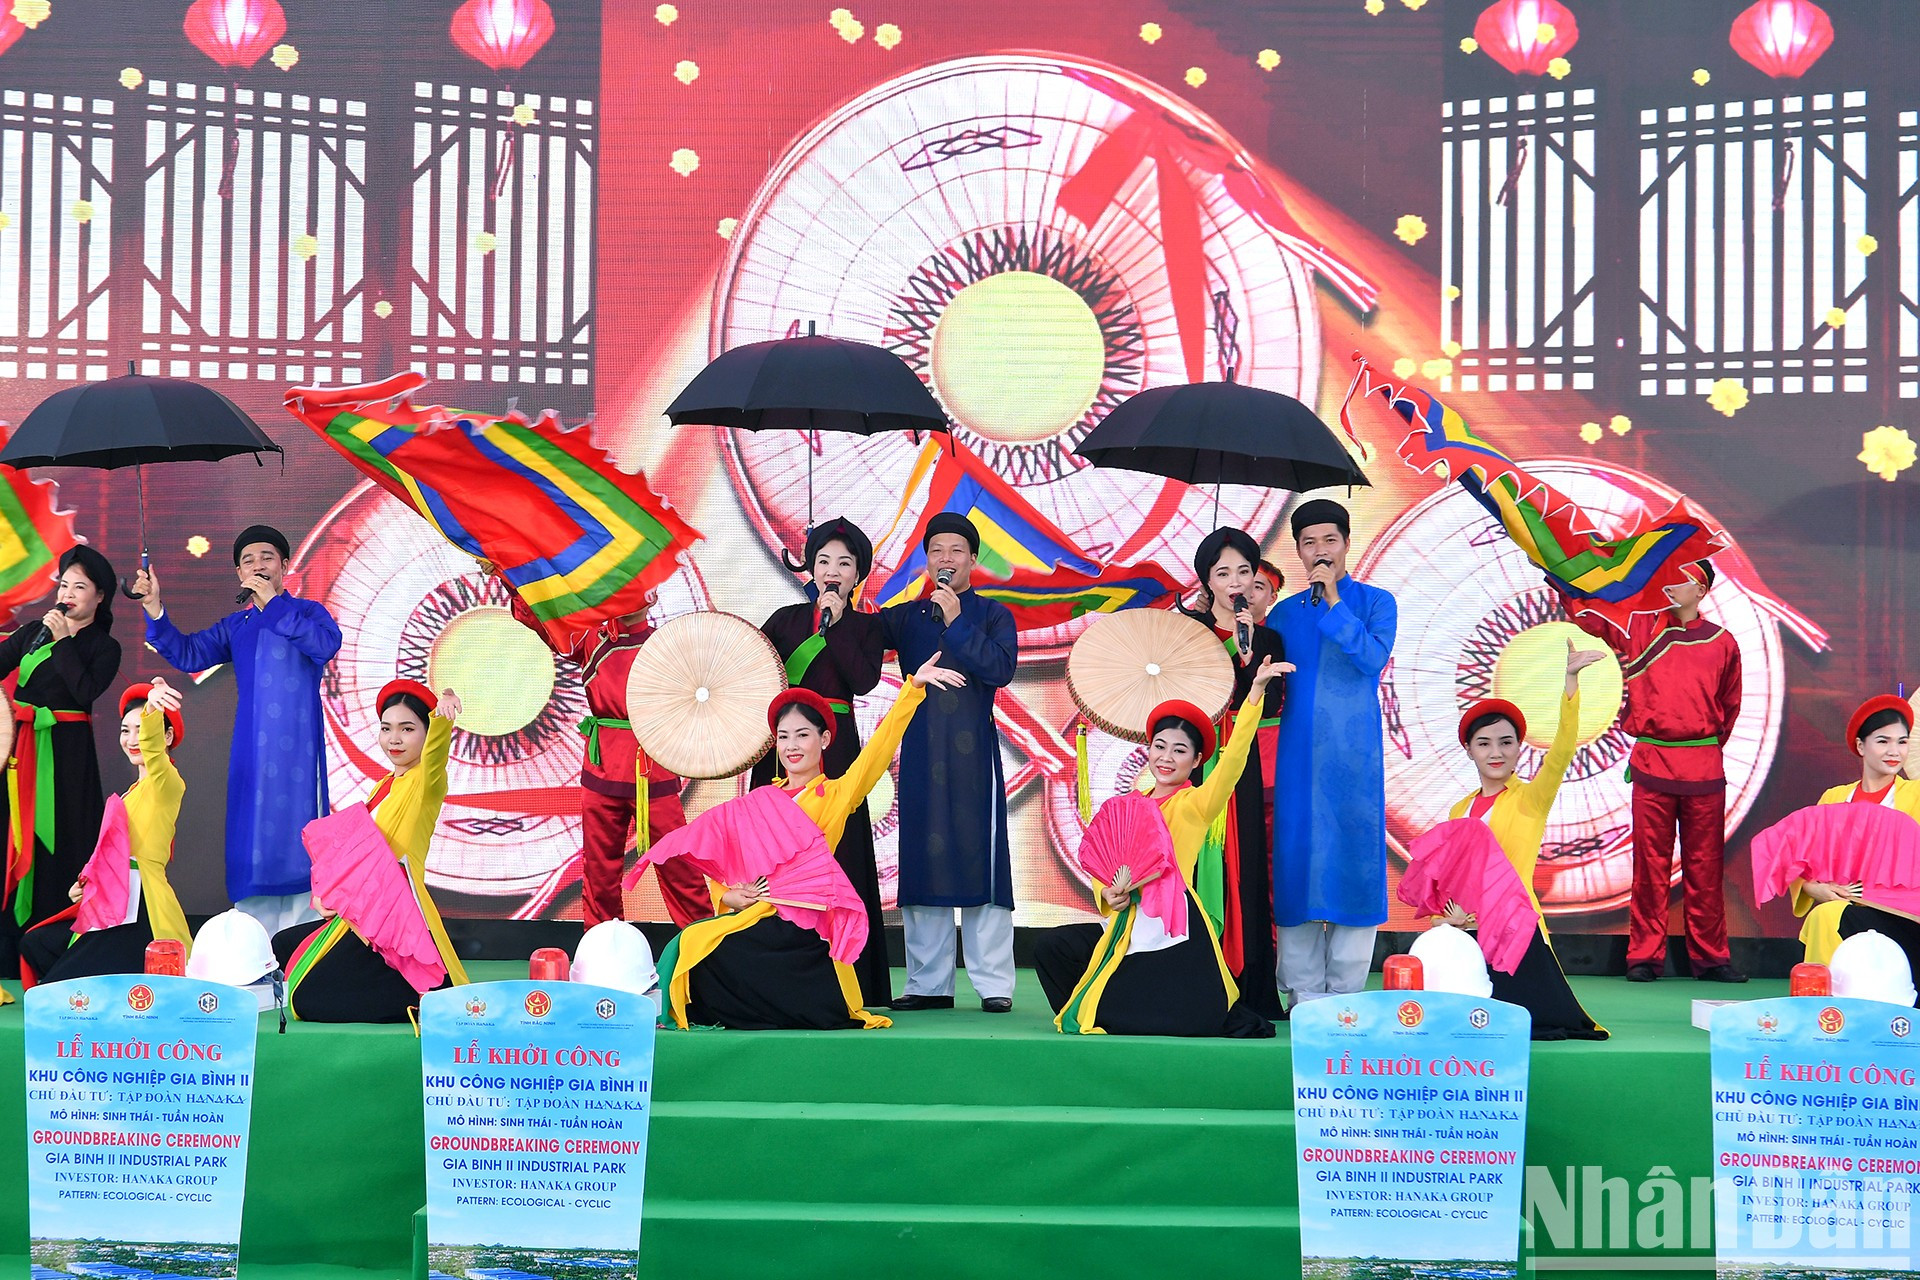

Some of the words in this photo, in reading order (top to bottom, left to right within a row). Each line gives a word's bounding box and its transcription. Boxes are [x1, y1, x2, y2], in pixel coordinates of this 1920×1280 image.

[56, 1033, 84, 1058] LỄ
[90, 1037, 150, 1059] KHỞI
[157, 1039, 222, 1061] CÔNG
[453, 1039, 481, 1064] LỄ
[488, 1043, 548, 1065] KHỞI
[555, 1045, 620, 1067] CÔNG
[1326, 1050, 1353, 1074] LỄ
[1361, 1054, 1422, 1076] KHỞI
[1429, 1056, 1495, 1077] CÔNG
[1744, 1056, 1772, 1080] LỄ
[1779, 1060, 1842, 1082] KHỞI
[1849, 1063, 1916, 1086] CÔNG
[29, 1070, 58, 1082] KHU
[63, 1068, 108, 1083] CÔNG
[113, 1069, 166, 1087] NGHIỆP
[170, 1073, 197, 1085] GIA
[202, 1070, 235, 1086] BÌNH
[241, 1074, 248, 1086] II
[426, 1076, 455, 1088] KHU
[460, 1072, 507, 1089] CÔNG
[511, 1075, 564, 1094] NGHIỆP
[568, 1079, 595, 1091] GIA
[600, 1076, 634, 1092] BÌNH
[639, 1080, 647, 1092] II
[29, 1088, 56, 1100] CHỦ
[145, 1090, 181, 1103] ĐOÀN
[426, 1094, 453, 1106] CHỦ
[543, 1096, 579, 1109] ĐOÀN
[1298, 1087, 1327, 1099] KHU
[1332, 1085, 1379, 1100] CÔNG
[1384, 1086, 1438, 1104] NGHIỆP
[1442, 1089, 1470, 1101] GIA
[1475, 1086, 1509, 1102] BÌNH
[1515, 1090, 1523, 1102] II
[1716, 1091, 1745, 1104] KHU
[1751, 1090, 1798, 1106] CÔNG
[1802, 1093, 1857, 1111] NGHIỆP
[1862, 1097, 1889, 1110] GIA
[1894, 1095, 1920, 1111] BÌN
[50, 1108, 67, 1119] MÔ
[71, 1109, 99, 1120] HÌNH:
[103, 1112, 127, 1121] SINH
[130, 1110, 153, 1121] THÁI
[193, 1112, 224, 1123] HOÀN
[1298, 1105, 1326, 1118] CHỦ
[1418, 1107, 1454, 1119] ĐOÀN
[1715, 1110, 1744, 1122] CHỦ
[1836, 1115, 1873, 1127] ĐOÀN
[448, 1114, 465, 1125] MÔ
[468, 1115, 497, 1126] HÌNH:
[500, 1118, 524, 1127] SINH
[528, 1116, 551, 1127] THÁI
[591, 1118, 622, 1129] HOÀN
[33, 1130, 161, 1147] GROUNDBREAKING
[166, 1133, 241, 1148] CEREMONY
[1320, 1126, 1338, 1137] MÔ
[1342, 1126, 1371, 1138] HÌNH:
[1374, 1129, 1399, 1138] SINH
[1402, 1127, 1426, 1138] THÁI
[1467, 1128, 1498, 1139] HOÀN
[1737, 1131, 1755, 1142] MÔ
[1759, 1131, 1788, 1143] HÌNH:
[1792, 1135, 1817, 1144] SINH
[1820, 1134, 1844, 1145] THÁI
[1885, 1137, 1917, 1149] HOÀN
[430, 1136, 560, 1153] GROUNDBREAKING
[564, 1139, 640, 1154] CEREMONY
[46, 1152, 70, 1164] GIA
[74, 1153, 104, 1165] BINH
[108, 1154, 115, 1165] II
[120, 1154, 190, 1166] INDUSTRIAL
[195, 1156, 227, 1167] PARK
[1303, 1148, 1435, 1164] GROUNDBREAKING
[1440, 1150, 1516, 1165] CEREMONY
[1720, 1152, 1853, 1172] GROUNDBREAKING
[443, 1158, 468, 1170] GIA
[472, 1159, 502, 1170] BINH
[506, 1160, 513, 1171] II
[518, 1160, 589, 1173] INDUSTRIAL
[593, 1162, 626, 1174] PARK
[55, 1172, 118, 1183] INVESTOR:
[123, 1174, 173, 1184] HANAKA
[176, 1175, 217, 1185] GROUP
[453, 1178, 516, 1189] INVESTOR:
[521, 1180, 571, 1190] HANAKA
[575, 1181, 616, 1191] GROUP
[1316, 1170, 1341, 1182] GIA
[1346, 1171, 1376, 1182] BINH
[1381, 1172, 1387, 1182] II
[1392, 1172, 1465, 1184] INDUSTRIAL
[1470, 1173, 1503, 1184] PARK
[1733, 1176, 1758, 1187] GIA
[1763, 1177, 1793, 1188] BINH
[1797, 1178, 1804, 1189] II
[1809, 1180, 1882, 1192] INDUSTRIAL
[59, 1190, 100, 1199] PATTERN:
[103, 1191, 166, 1201] ECOLOGICAL
[176, 1193, 212, 1202] CYCLIC
[457, 1196, 498, 1205] PATTERN:
[502, 1197, 565, 1207] ECOLOGICAL
[575, 1199, 611, 1208] CYCLIC
[1327, 1190, 1391, 1201] INVESTOR:
[1396, 1191, 1448, 1201] HANAKA
[1451, 1192, 1493, 1202] GROUP
[1742, 1196, 1808, 1207] INVESTOR:
[1812, 1198, 1864, 1209] HANAKA
[1867, 1201, 1911, 1211] GROUP
[1331, 1208, 1373, 1217] PATTERN:
[1376, 1209, 1442, 1218] ECOLOGICAL
[1451, 1210, 1488, 1219] CYCLIC
[1746, 1214, 1789, 1223] PATTERN:
[1792, 1216, 1857, 1225] ECOLOGICAL
[1867, 1219, 1905, 1228] CYCLIC
